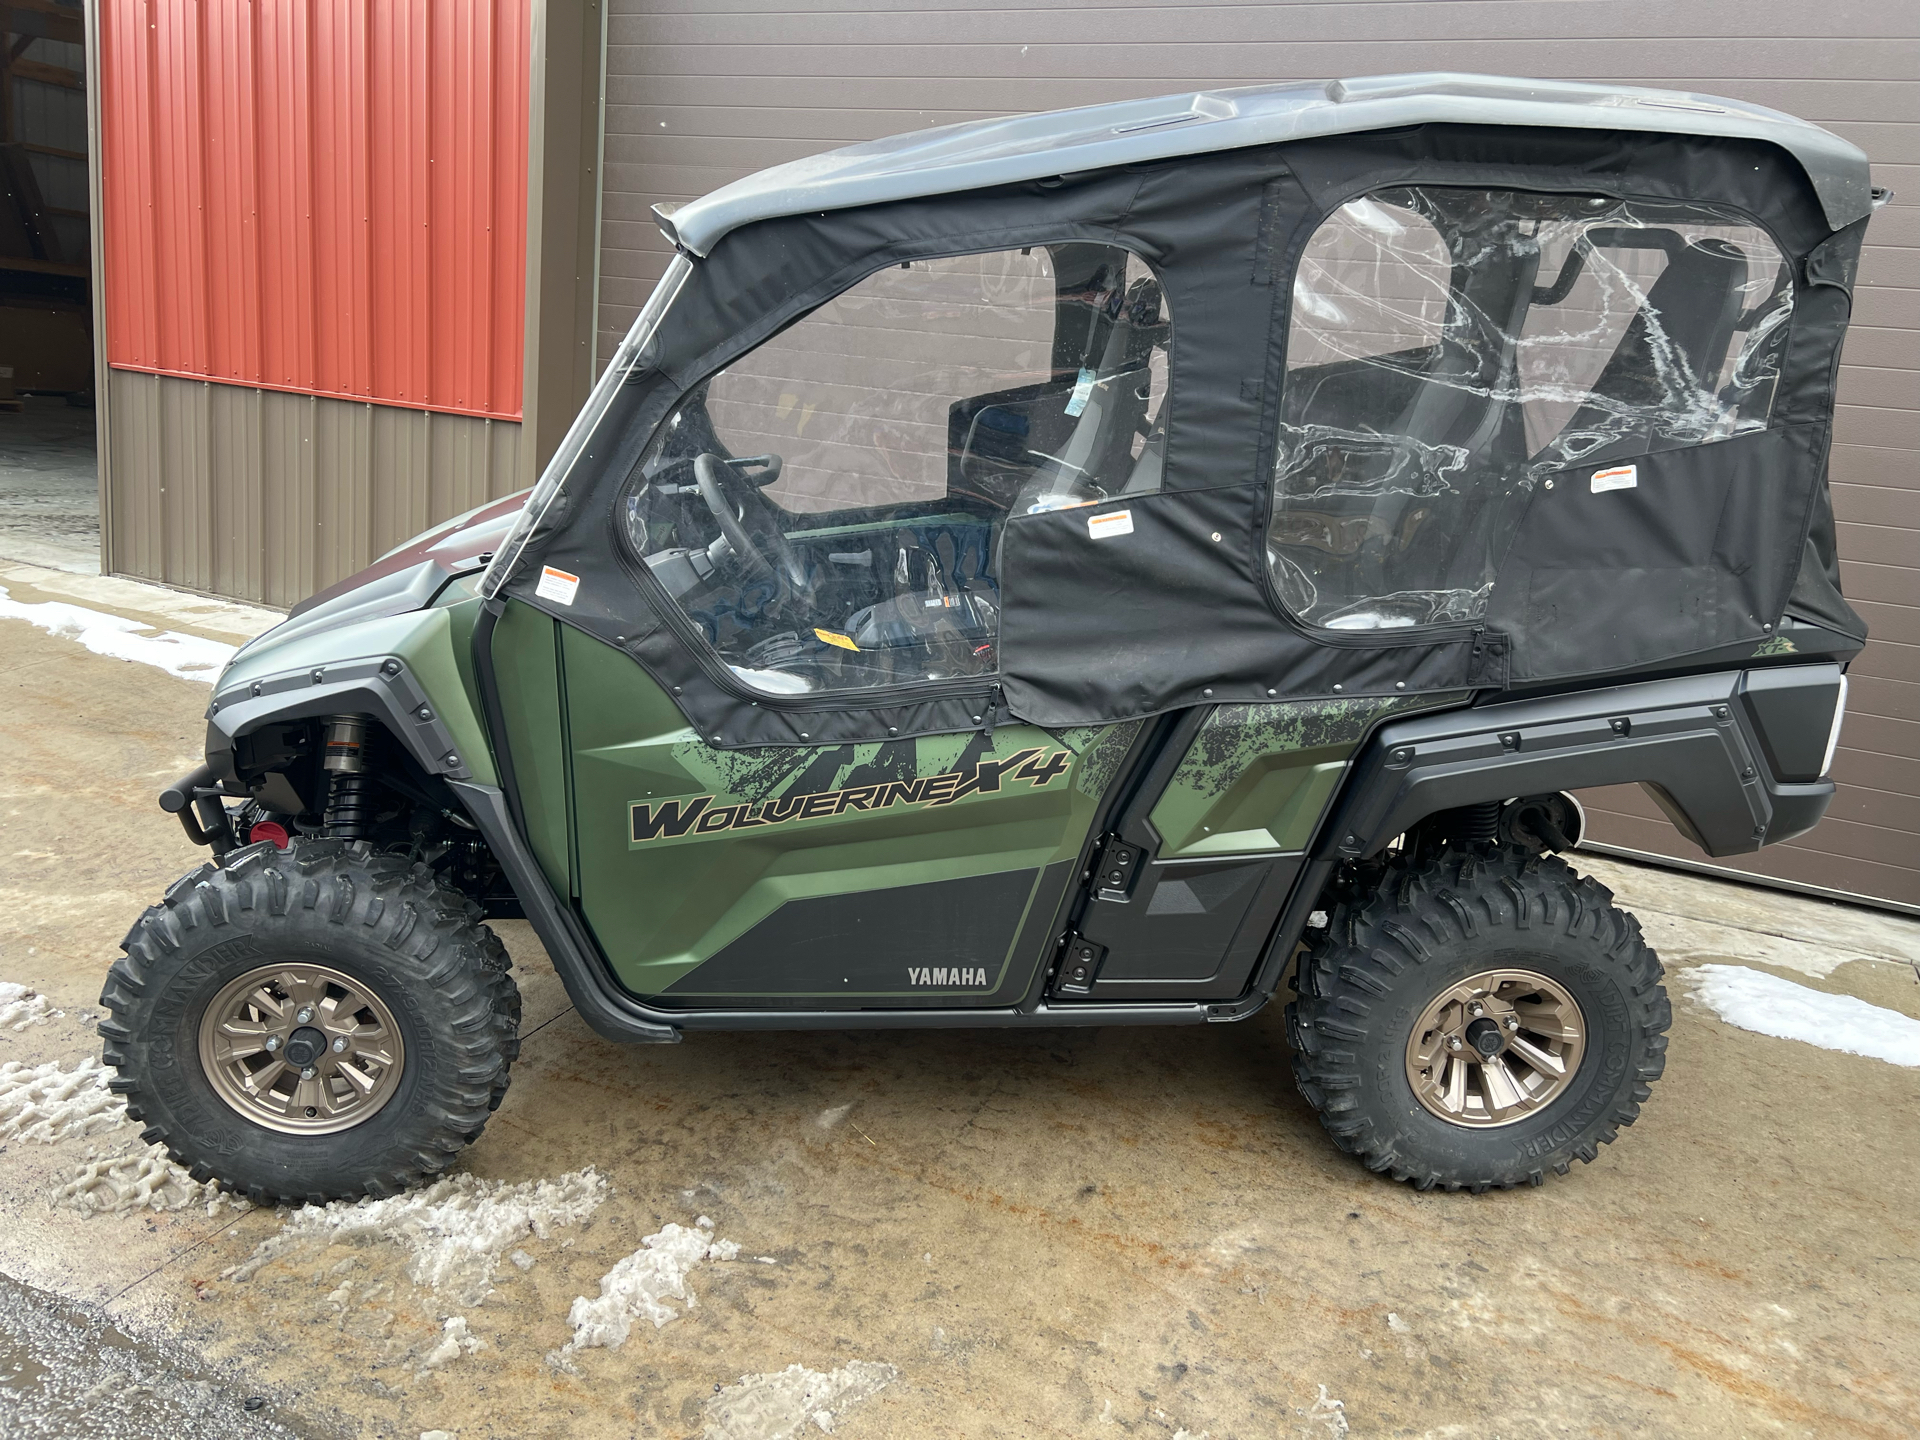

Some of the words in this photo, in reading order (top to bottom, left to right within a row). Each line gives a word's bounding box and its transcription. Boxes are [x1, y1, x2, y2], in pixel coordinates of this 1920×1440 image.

[908, 967, 987, 986] YAMAHA
[150, 940, 250, 1070] COMMANDER
[1600, 989, 1627, 1033] DIRT
[156, 1076, 201, 1125] DIRT
[1526, 1042, 1630, 1158] COMMANDER
